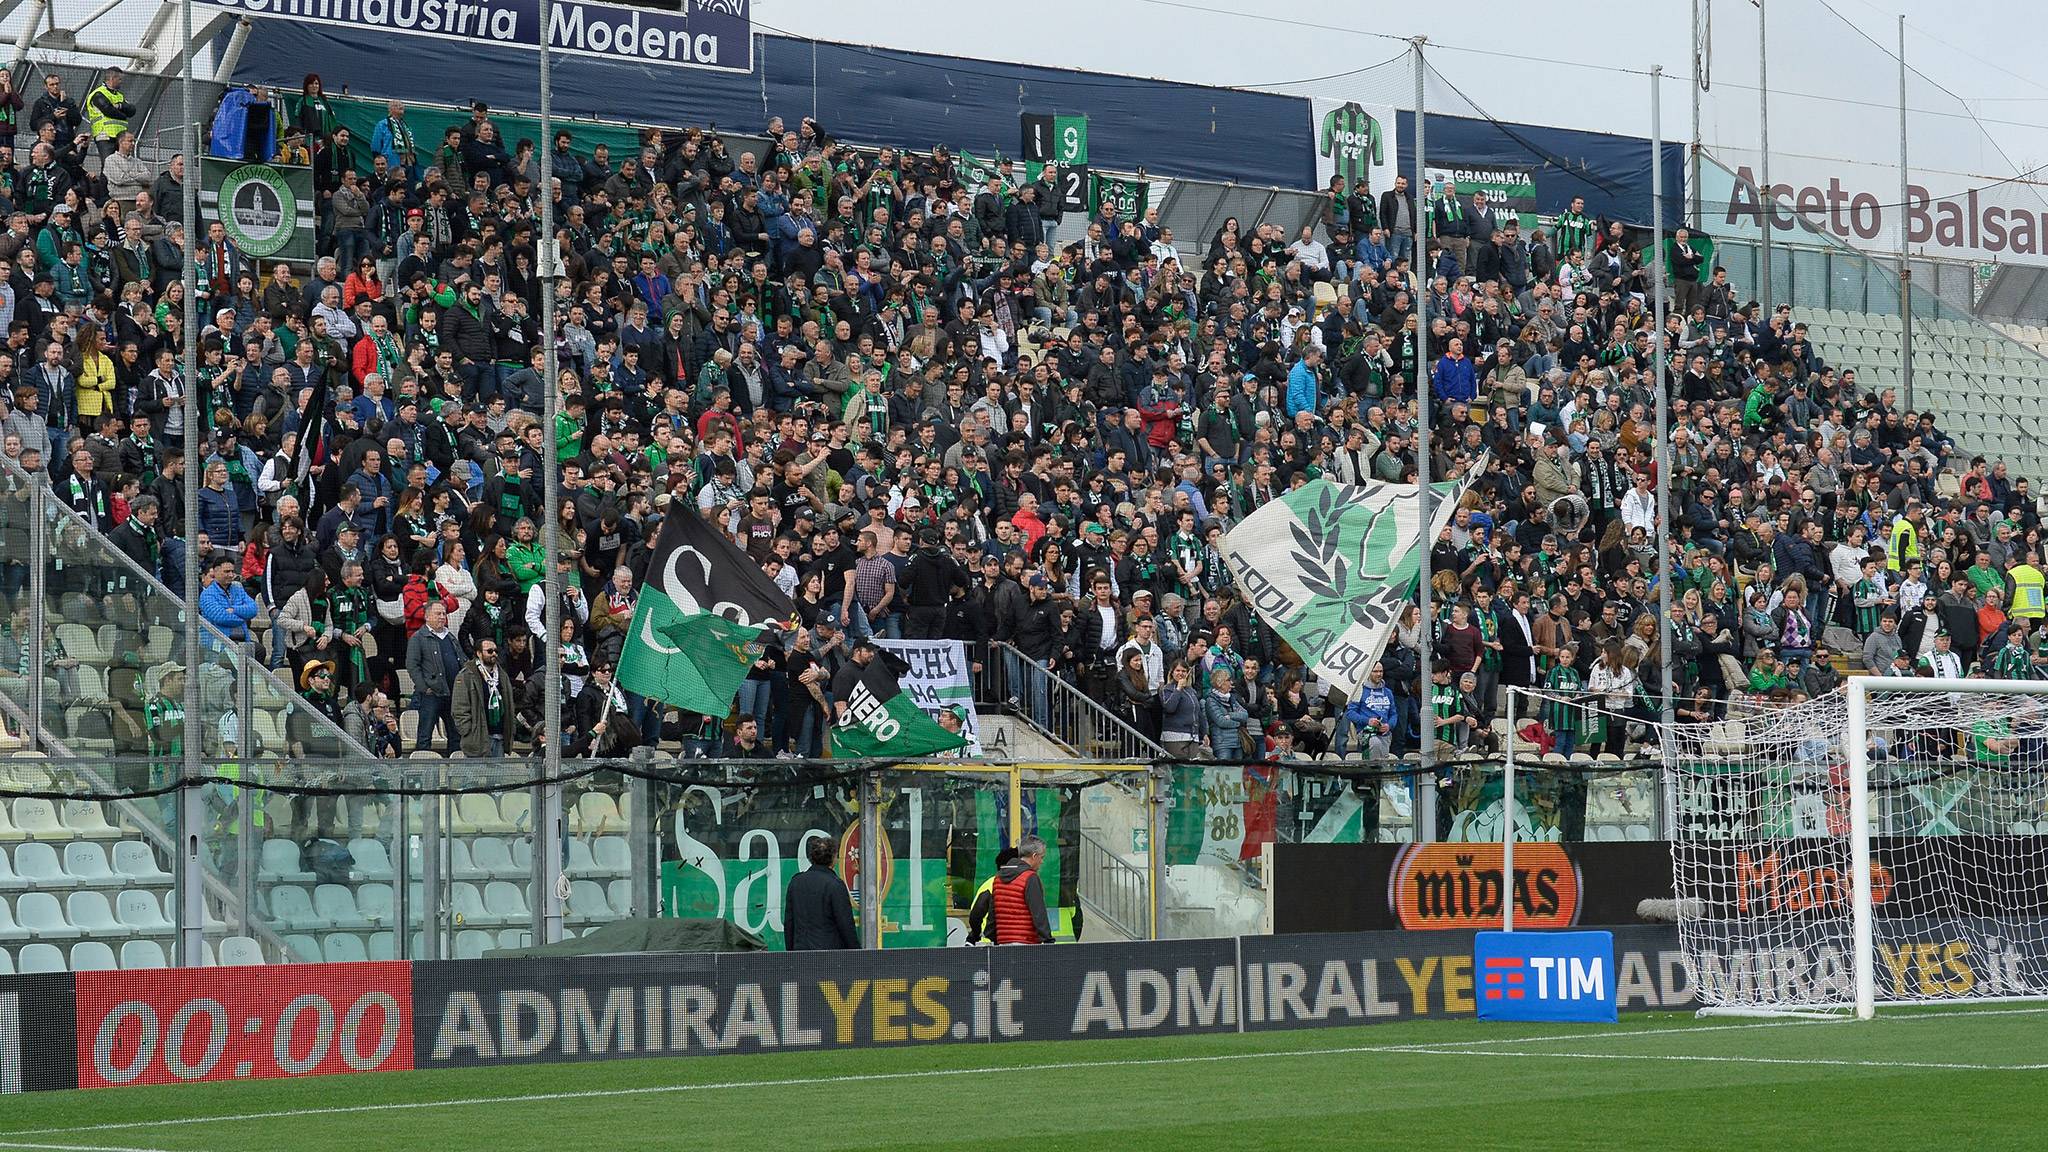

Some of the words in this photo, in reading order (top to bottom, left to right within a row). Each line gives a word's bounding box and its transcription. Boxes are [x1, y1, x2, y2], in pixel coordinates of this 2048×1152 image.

[548, 3, 718, 64] Modena
[1335, 129, 1368, 147] NOCE
[1454, 169, 1532, 186] GRADINATA
[1725, 166, 1882, 240] Aceto
[1906, 184, 2048, 256] Balsa
[848, 679, 900, 742] FIERO
[1211, 815, 1240, 841] 88
[1071, 955, 1473, 1034] ADMIRALYE
[1529, 956, 1605, 1000] TIM
[1616, 935, 2026, 1008] ADMIRAYES.it
[93, 991, 401, 1084] 00:00
[431, 969, 1025, 1061] ADMIRALYES.it
